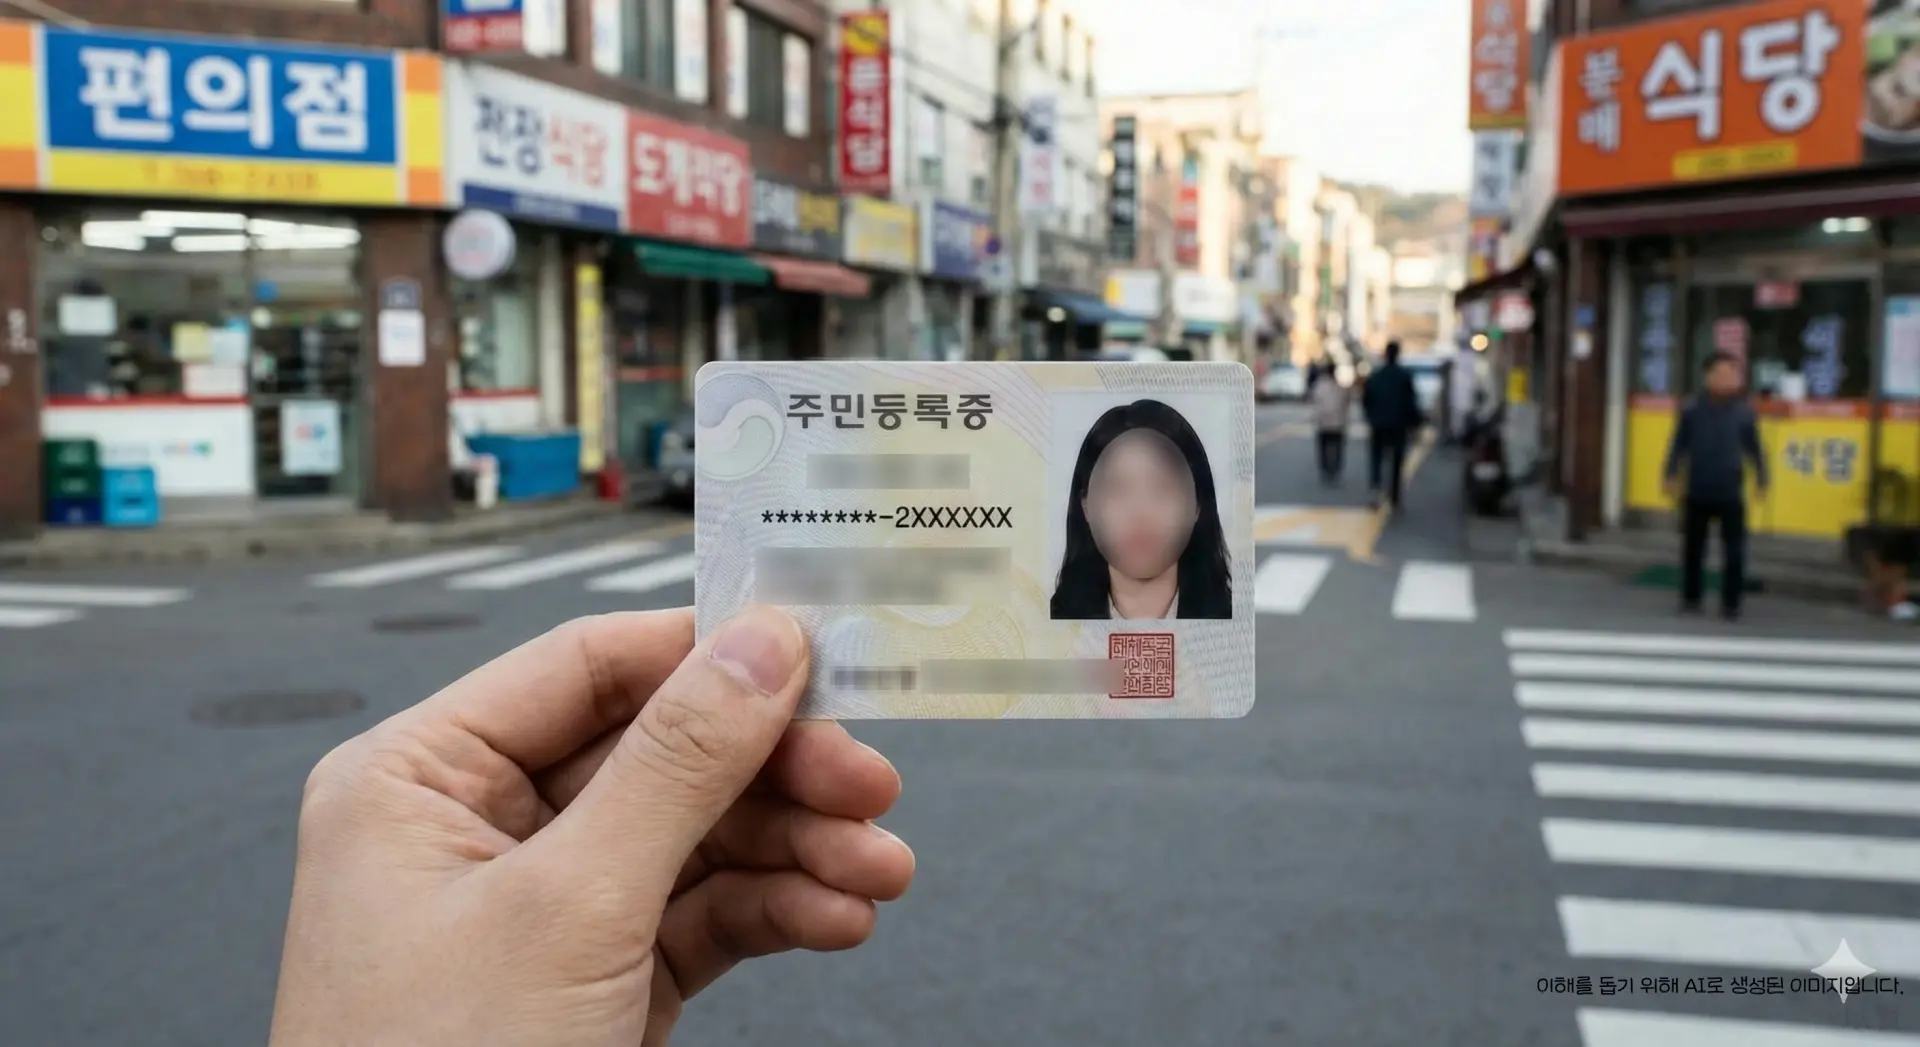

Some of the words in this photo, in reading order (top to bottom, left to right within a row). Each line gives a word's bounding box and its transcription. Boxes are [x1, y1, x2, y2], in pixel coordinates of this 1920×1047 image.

[79, 46, 368, 153] 편의점
[1641, 8, 1841, 141] 식당
[787, 395, 992, 430] 주민등록증
